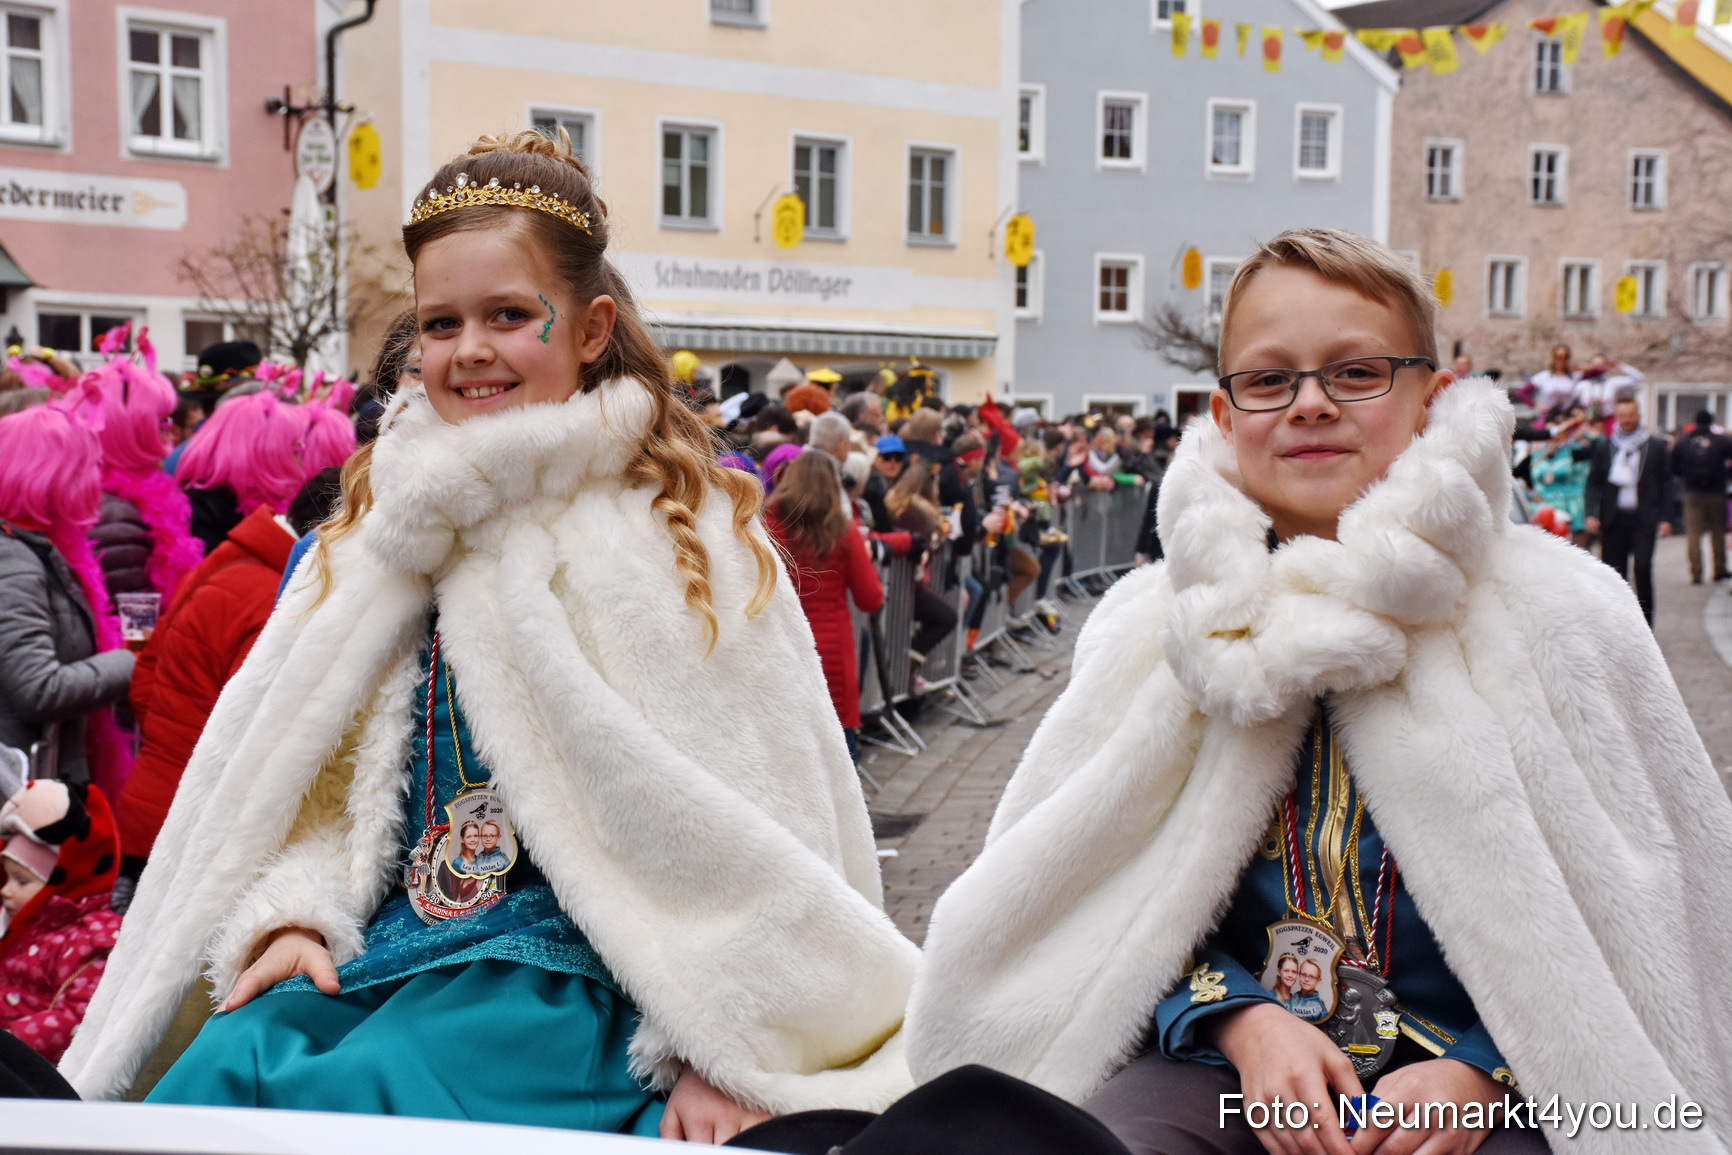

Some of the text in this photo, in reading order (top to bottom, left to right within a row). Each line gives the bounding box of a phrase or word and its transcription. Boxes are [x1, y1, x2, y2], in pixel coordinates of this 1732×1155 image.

[655, 260, 853, 301] Schuhmoden Döllinger
[454, 794, 488, 809] EGGSPATZEN
[480, 864, 496, 872] Niklas
[424, 903, 453, 917] SABRINA
[1275, 925, 1337, 952] EGGSPATZEN EGWEIL
[1313, 945, 1328, 955] 2020
